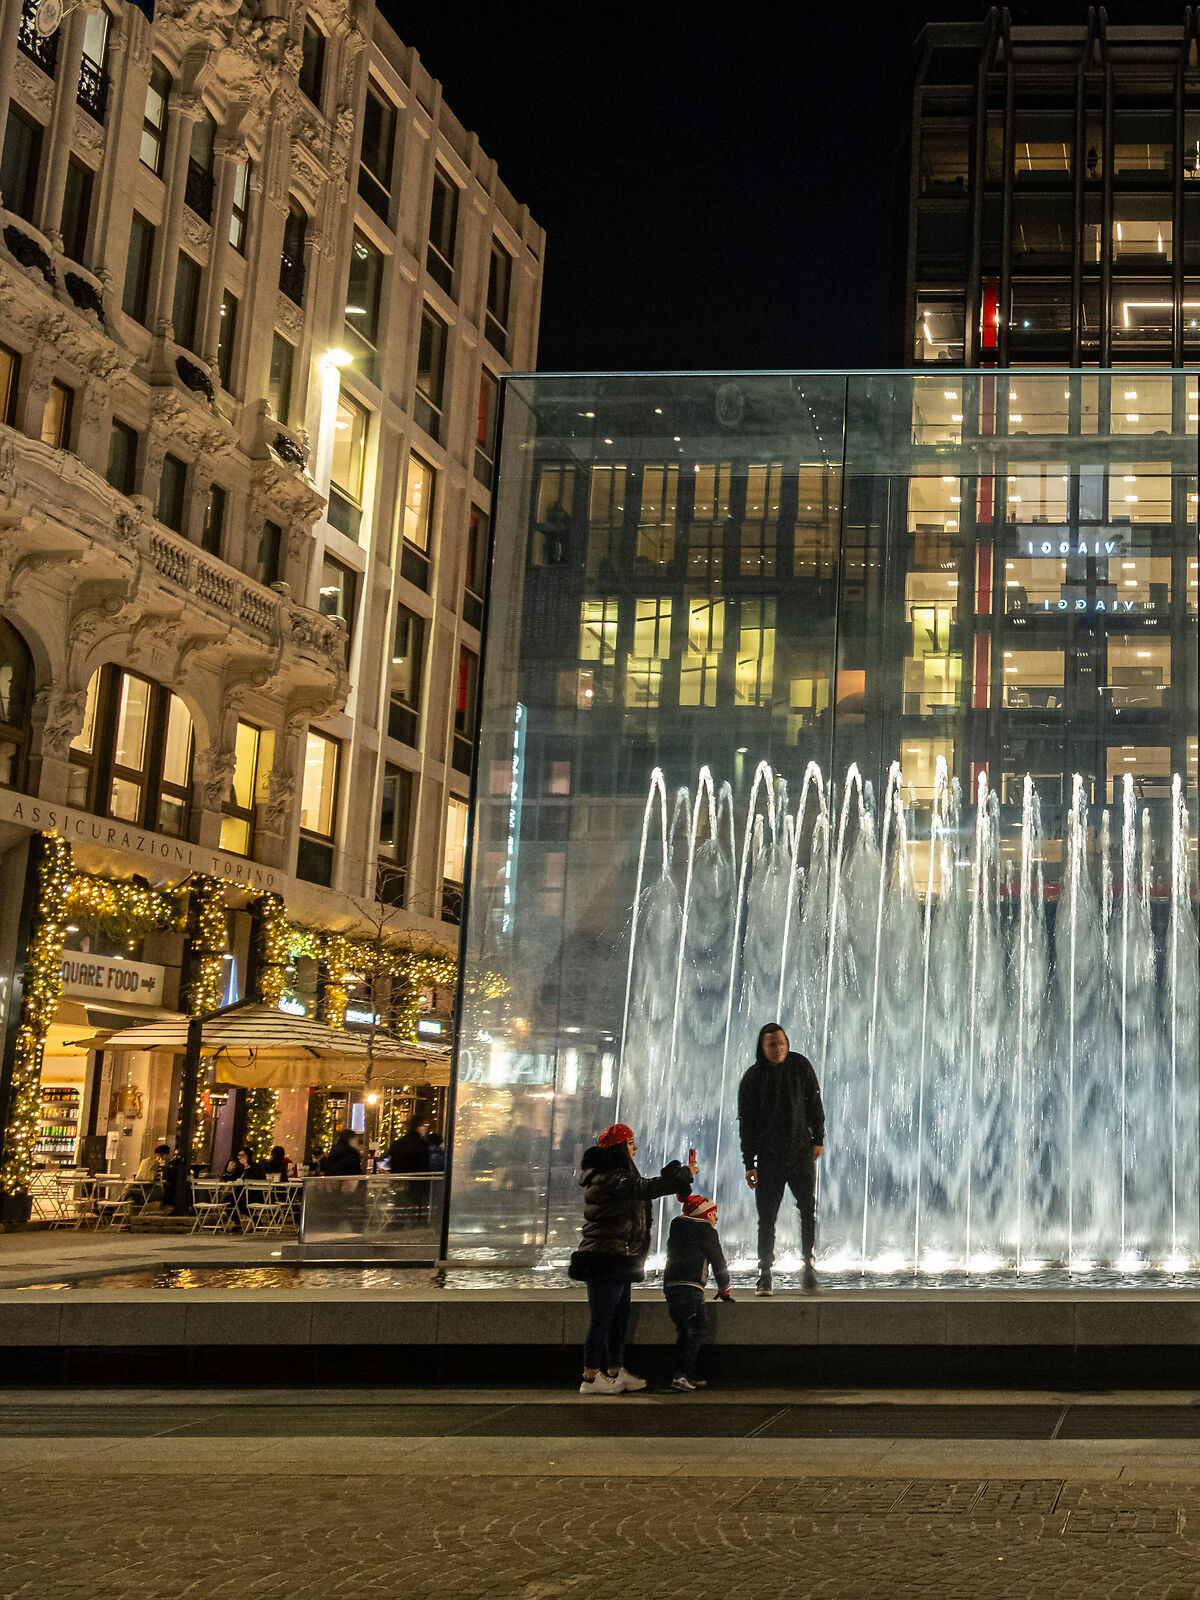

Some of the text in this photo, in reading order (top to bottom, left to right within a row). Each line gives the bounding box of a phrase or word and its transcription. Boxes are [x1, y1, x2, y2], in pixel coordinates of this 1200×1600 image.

[13, 802, 274, 887] ASSICURAZIONI TORINO
[57, 959, 104, 988] QUARE
[107, 967, 139, 992] FOOD
